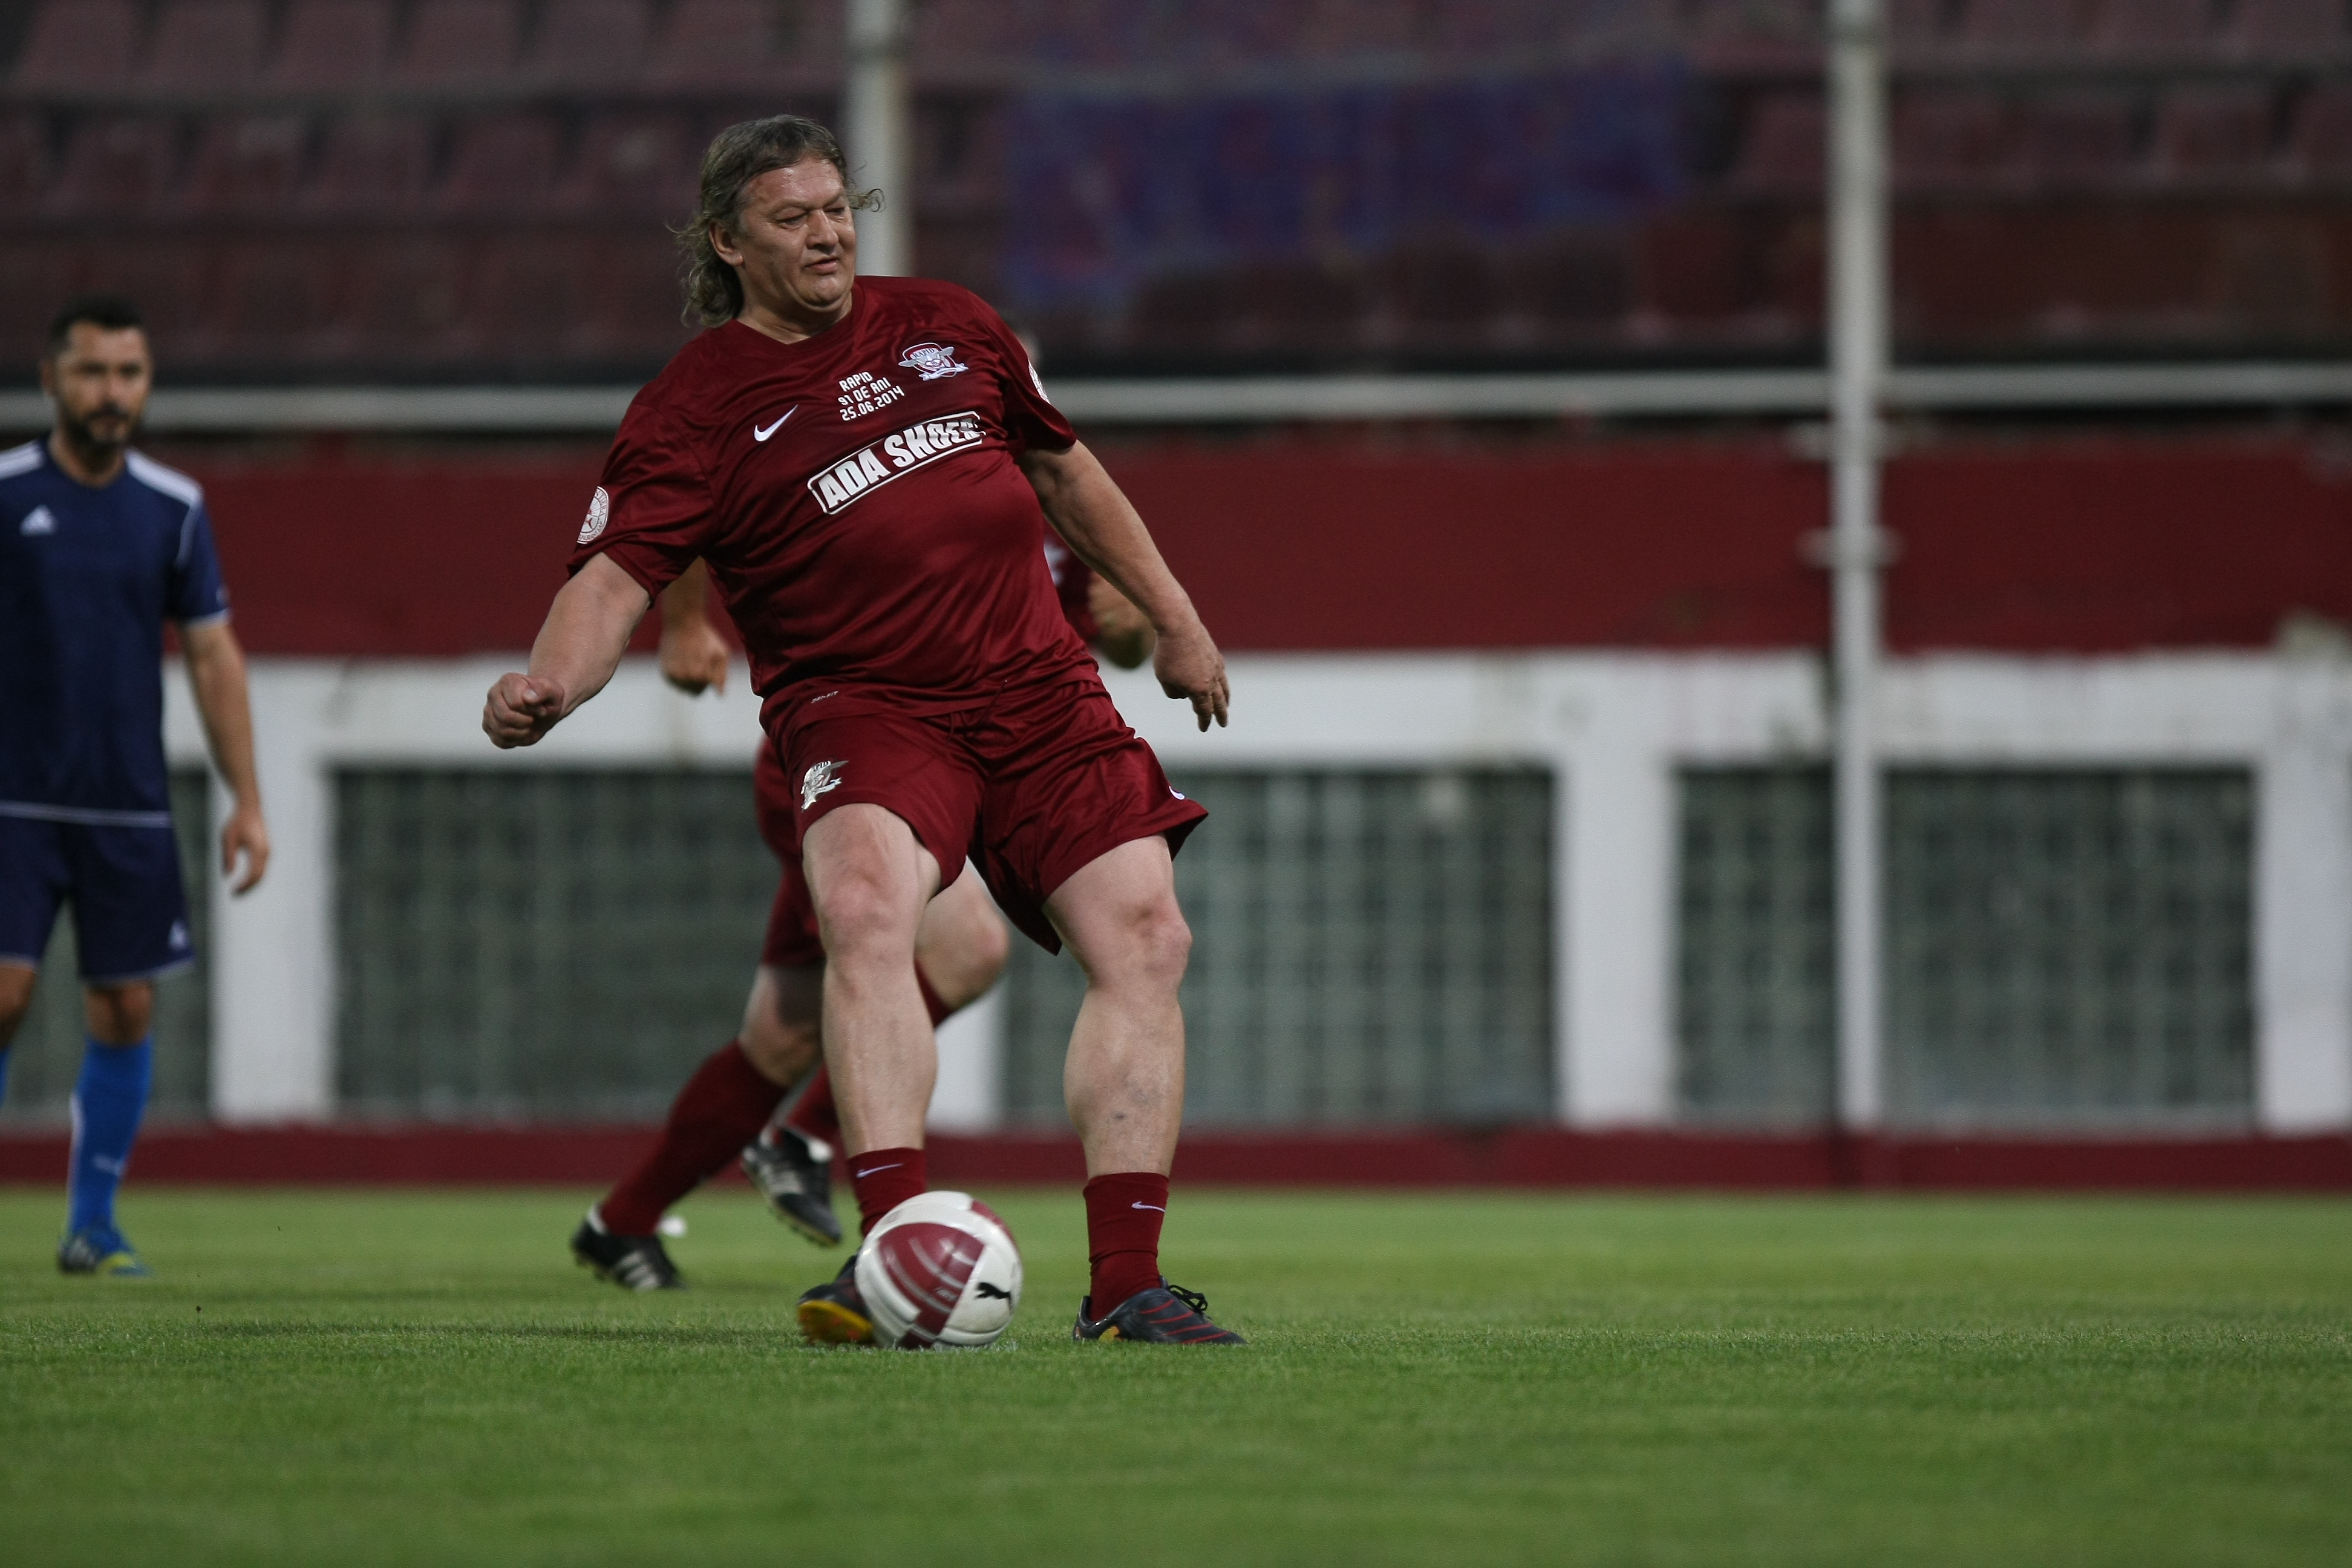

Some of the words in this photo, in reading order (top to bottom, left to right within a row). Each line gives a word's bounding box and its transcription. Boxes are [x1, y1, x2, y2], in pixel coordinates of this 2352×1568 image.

[837, 394, 854, 405] 91
[852, 385, 871, 402] DE
[869, 377, 892, 394] ANI
[838, 371, 873, 392] RAPID
[839, 385, 905, 421] 25.06.2014
[818, 448, 891, 509] ADA
